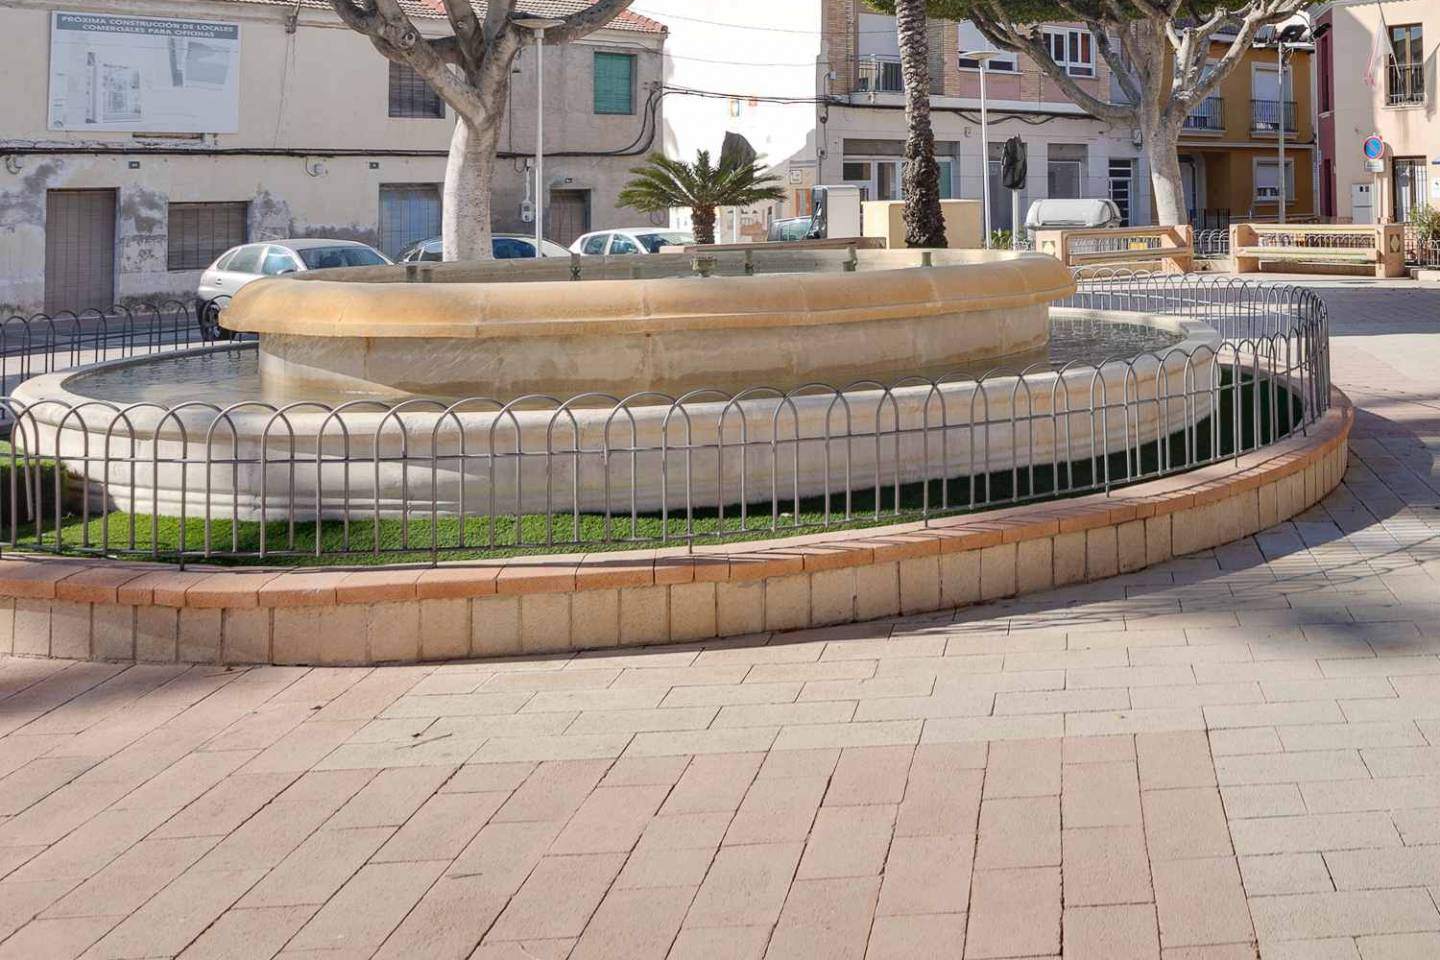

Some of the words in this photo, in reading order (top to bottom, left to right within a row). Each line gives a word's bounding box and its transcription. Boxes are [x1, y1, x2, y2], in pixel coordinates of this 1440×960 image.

[82, 23, 146, 33] COMERCIALES
[175, 29, 214, 37] OFICINAS
[197, 24, 233, 32] LOCALES
